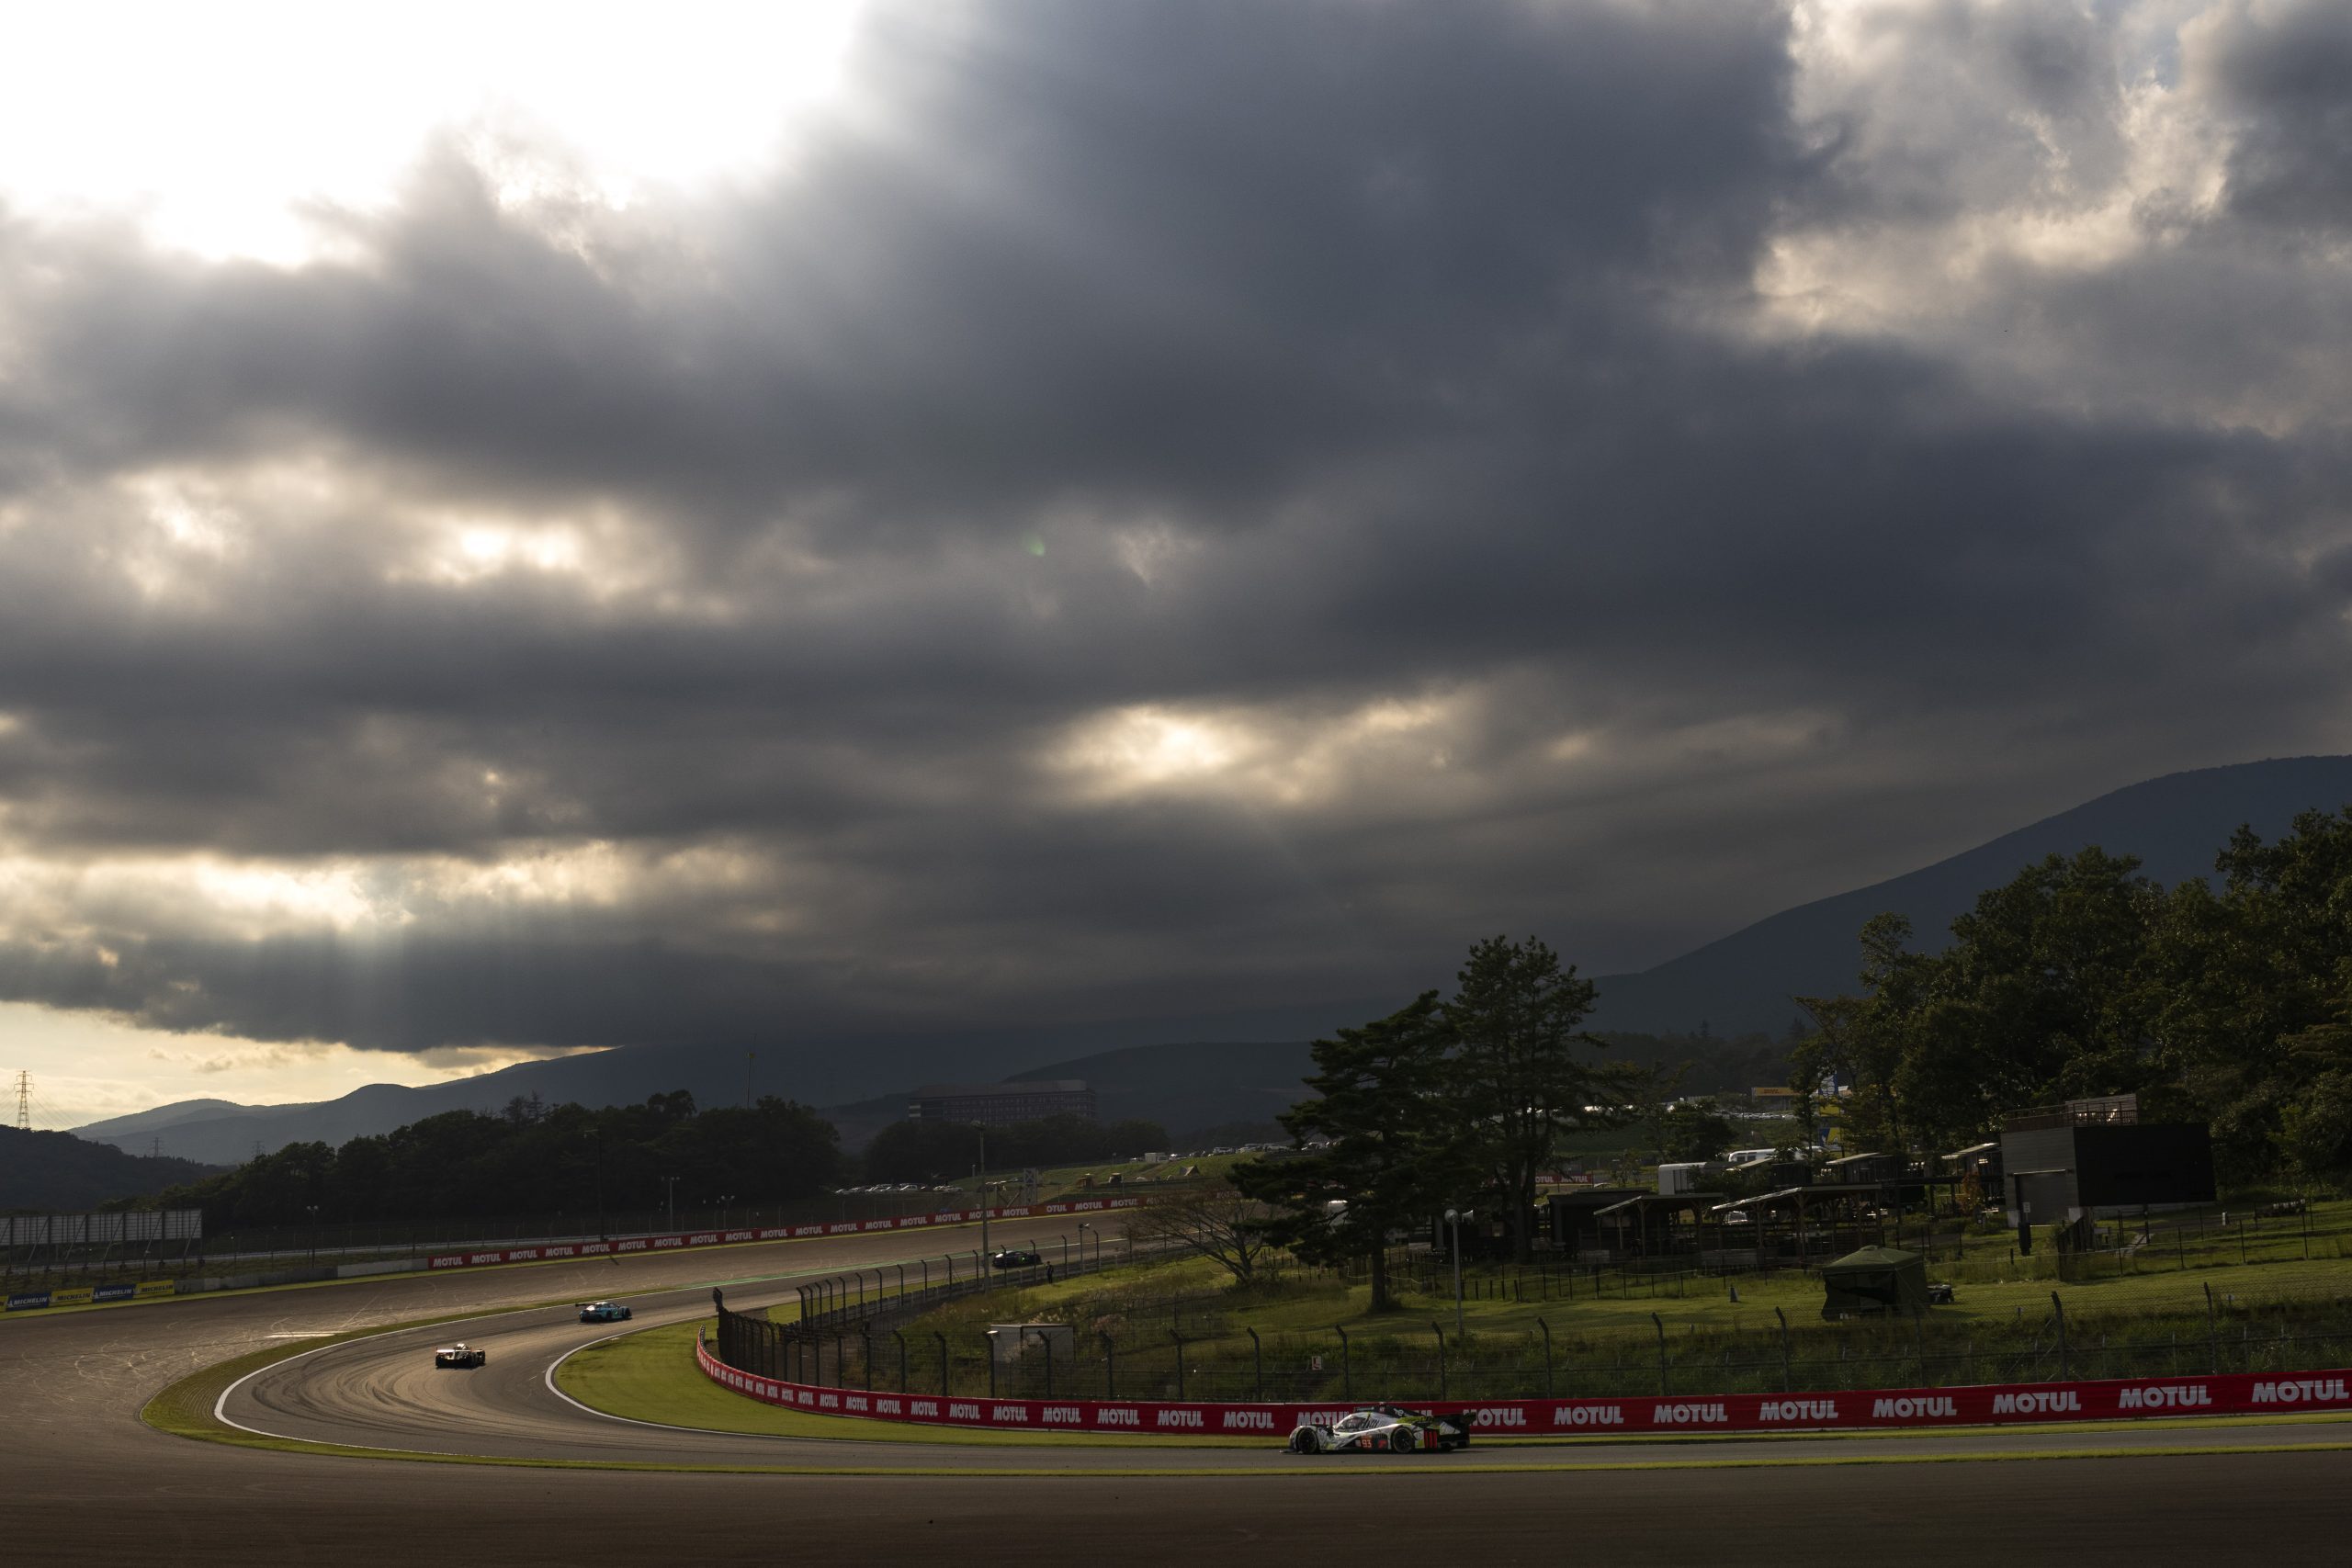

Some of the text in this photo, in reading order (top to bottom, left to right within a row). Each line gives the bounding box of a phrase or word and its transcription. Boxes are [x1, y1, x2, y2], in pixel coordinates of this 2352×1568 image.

[1002, 1207, 1030, 1217] MOTUL
[1046, 1204, 1068, 1213] OTUL
[1075, 1201, 1103, 1211] MOTUL
[900, 1216, 927, 1226] MOTUL
[935, 1213, 962, 1223] MOTUL
[795, 1225, 823, 1236] MOTUL
[831, 1223, 858, 1234] MOTUL
[865, 1219, 893, 1230] MOTUL
[690, 1234, 718, 1245] MOTUL
[725, 1231, 753, 1242] MOTUL
[760, 1228, 788, 1239] MOTUL
[618, 1240, 647, 1251] MOTUL
[654, 1237, 683, 1247] MOTUL
[509, 1248, 537, 1260] MOTUL
[545, 1246, 574, 1257] MOTUL
[582, 1243, 610, 1254] MOTUL
[434, 1256, 463, 1267] MOTUL
[471, 1253, 502, 1264] MOTUL
[2119, 1385, 2212, 1408] MOTUL
[2251, 1379, 2350, 1403] MOTUL
[820, 1393, 839, 1408] MOTUL
[846, 1395, 868, 1412] MOTUL
[1872, 1396, 1957, 1417] MOTUL
[1992, 1392, 2082, 1414] MOTUL
[876, 1399, 901, 1415] MOTUL
[910, 1401, 938, 1416] MOTUL
[949, 1404, 980, 1420] MOTUL
[1758, 1400, 1838, 1420] MOTUL
[992, 1406, 1028, 1422] MOTUL
[1042, 1407, 1081, 1424] MOTUL
[1097, 1408, 1140, 1426] MOTUL
[1158, 1410, 1204, 1427] MOTUL
[1554, 1405, 1624, 1425] MOTUL
[1653, 1403, 1728, 1424] MOTUL
[1223, 1411, 1274, 1429] MOTUL
